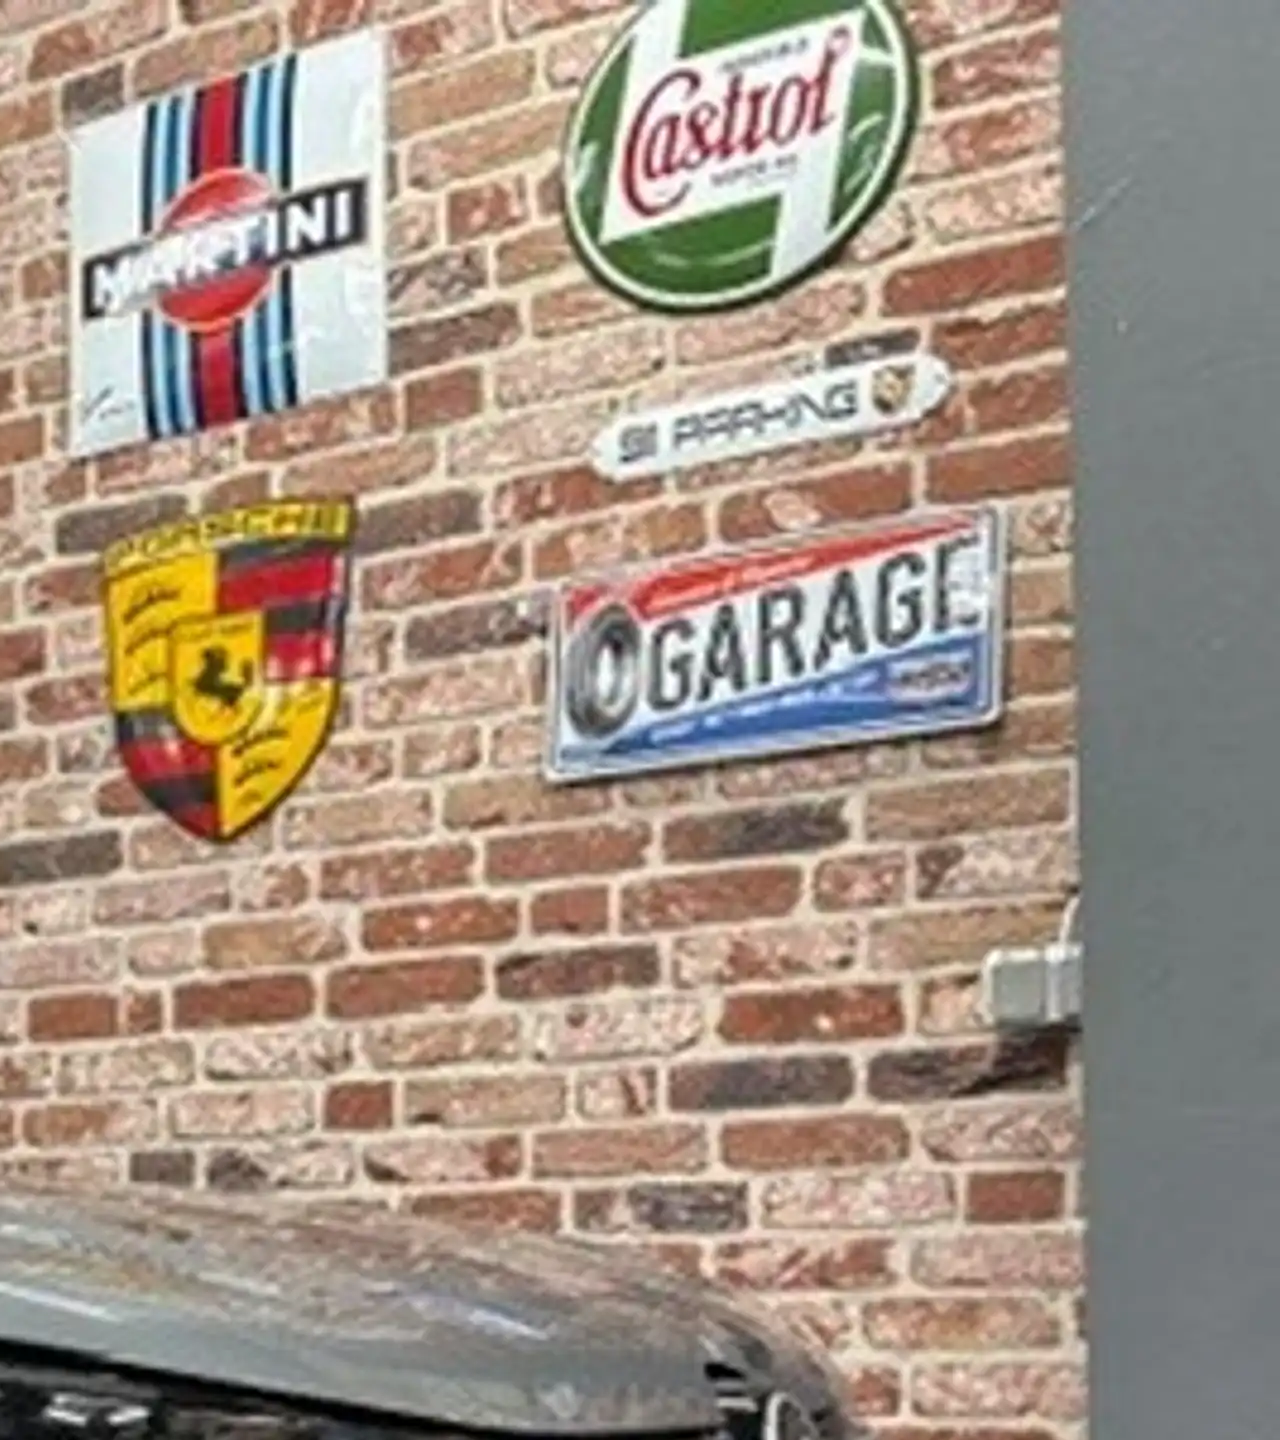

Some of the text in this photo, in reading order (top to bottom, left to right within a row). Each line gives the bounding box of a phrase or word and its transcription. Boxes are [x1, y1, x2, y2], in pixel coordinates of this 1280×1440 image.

[622, 26, 852, 218] Castrol
[93, 190, 352, 315] MARTINI
[646, 532, 982, 712] GARAGE
